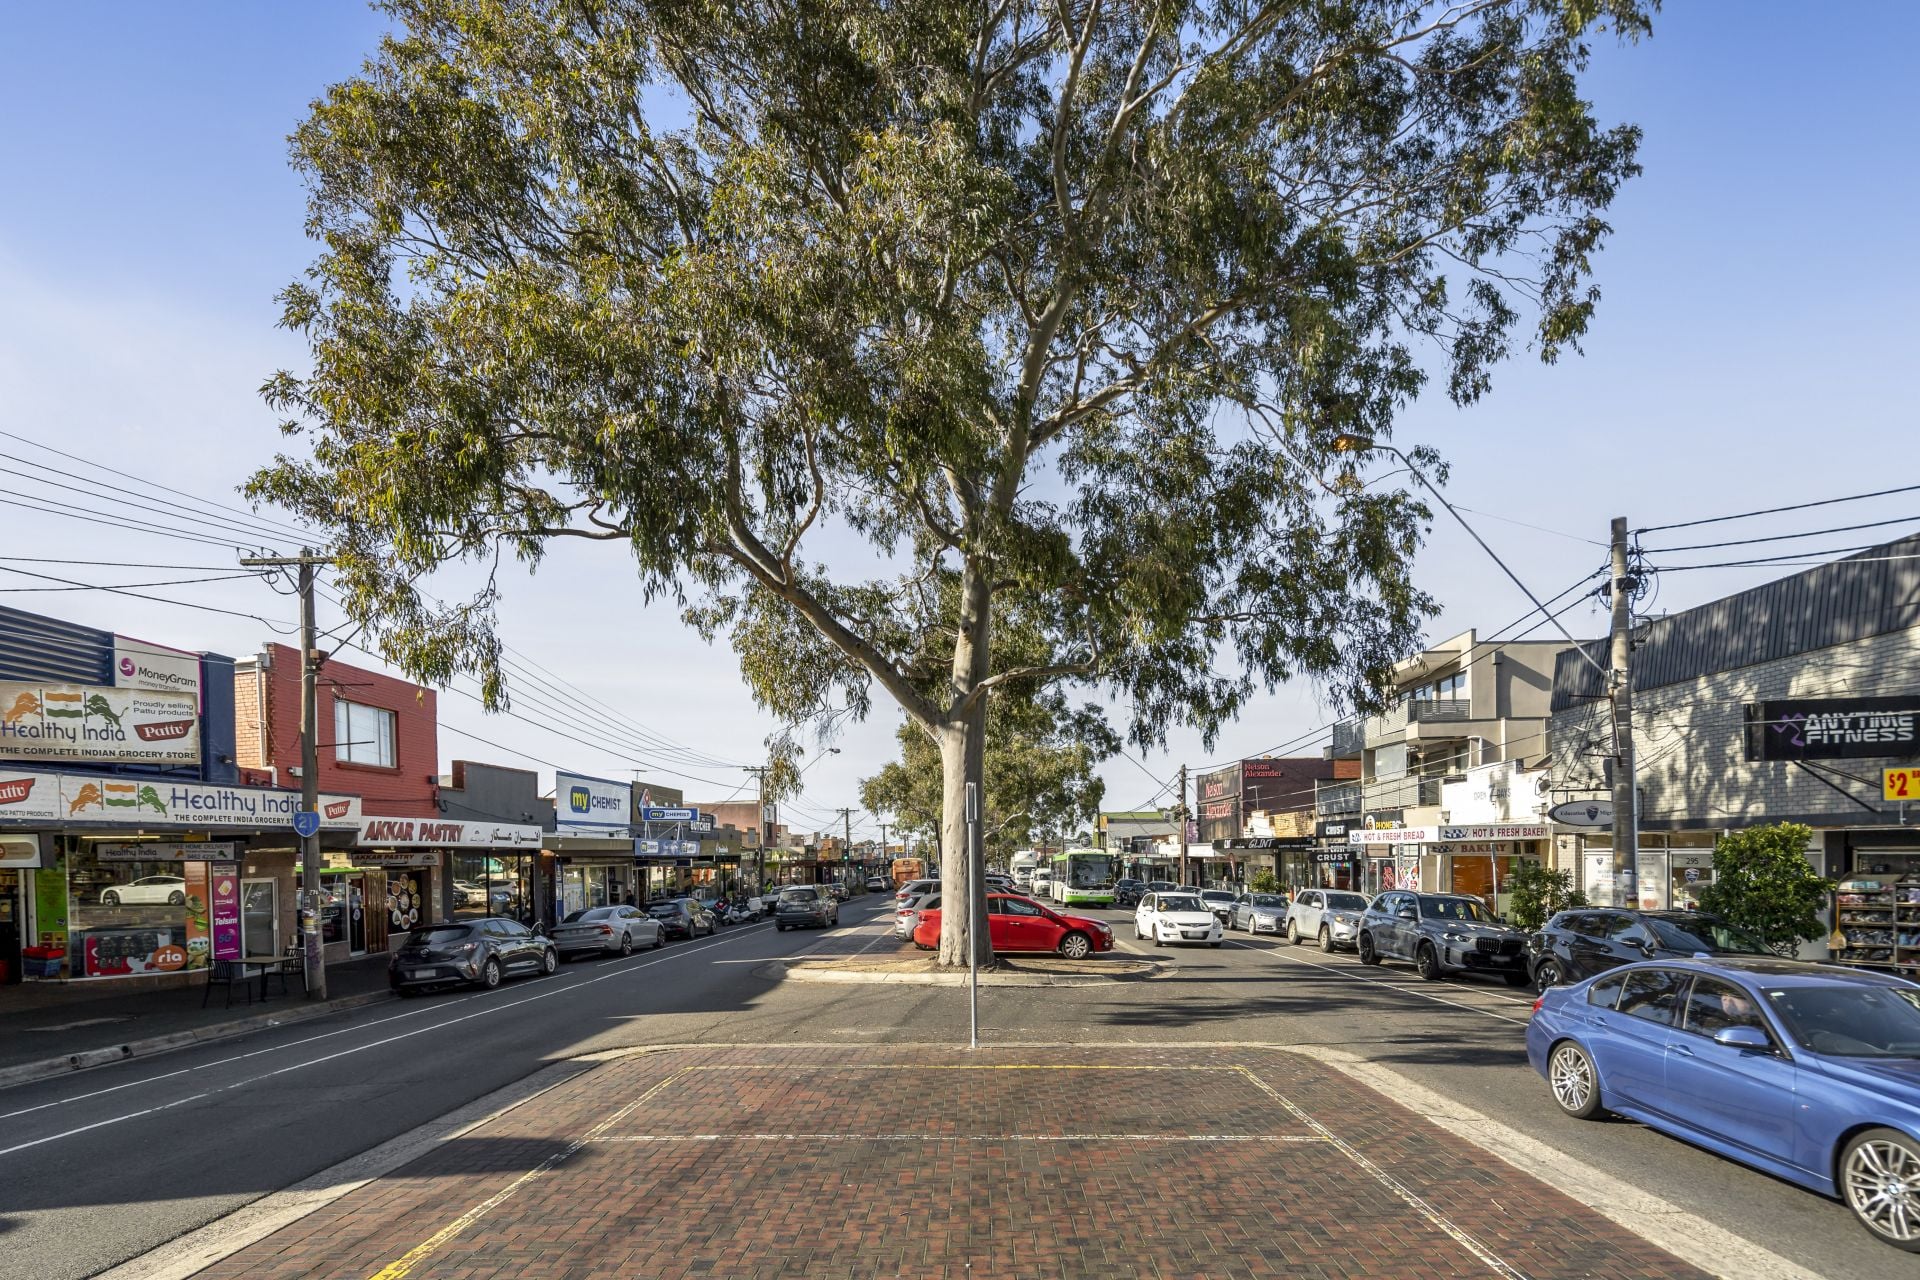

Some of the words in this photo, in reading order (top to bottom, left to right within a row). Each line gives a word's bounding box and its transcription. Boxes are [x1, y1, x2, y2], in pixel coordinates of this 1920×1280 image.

[138, 667, 197, 687] MoneyGram
[133, 700, 165, 708] Proudly
[168, 702, 194, 710] selling
[1804, 711, 1914, 731] ANYTIME
[1, 720, 77, 743] Healthy
[82, 723, 126, 741] India
[143, 725, 184, 738] Pattu
[1806, 727, 1914, 745] FITNESS
[0, 746, 20, 754] THE
[23, 747, 79, 756] COMPLETE
[81, 749, 116, 757] INDIAN
[118, 750, 164, 758] GROCERY
[1244, 763, 1270, 771] Nelson
[1245, 769, 1282, 777] Alexander
[0, 783, 26, 799] attu
[1205, 781, 1223, 798] Nelson
[1889, 772, 1908, 797] $2
[1496, 787, 1511, 798] DAYS
[171, 788, 256, 816] Healthy
[572, 792, 588, 811] my
[591, 796, 621, 810] CHEMIST
[1206, 800, 1232, 819] Alexander
[174, 814, 190, 822] THE
[192, 815, 231, 823] COMPLETE
[298, 815, 313, 829] 21
[363, 820, 414, 841] AKKAR
[418, 822, 464, 842] PASTRY
[1325, 825, 1345, 835] CRUST
[1383, 832, 1401, 840] FRESH
[1403, 830, 1425, 840] BREAD
[1472, 828, 1487, 838] HOT
[1489, 829, 1495, 837] &
[1497, 827, 1519, 837] FRESH
[1523, 827, 1548, 837] BAKERY
[1248, 839, 1275, 849] GLINT
[105, 849, 136, 858] Healthy
[1316, 853, 1350, 861] CRUST
[158, 950, 182, 963] ria
